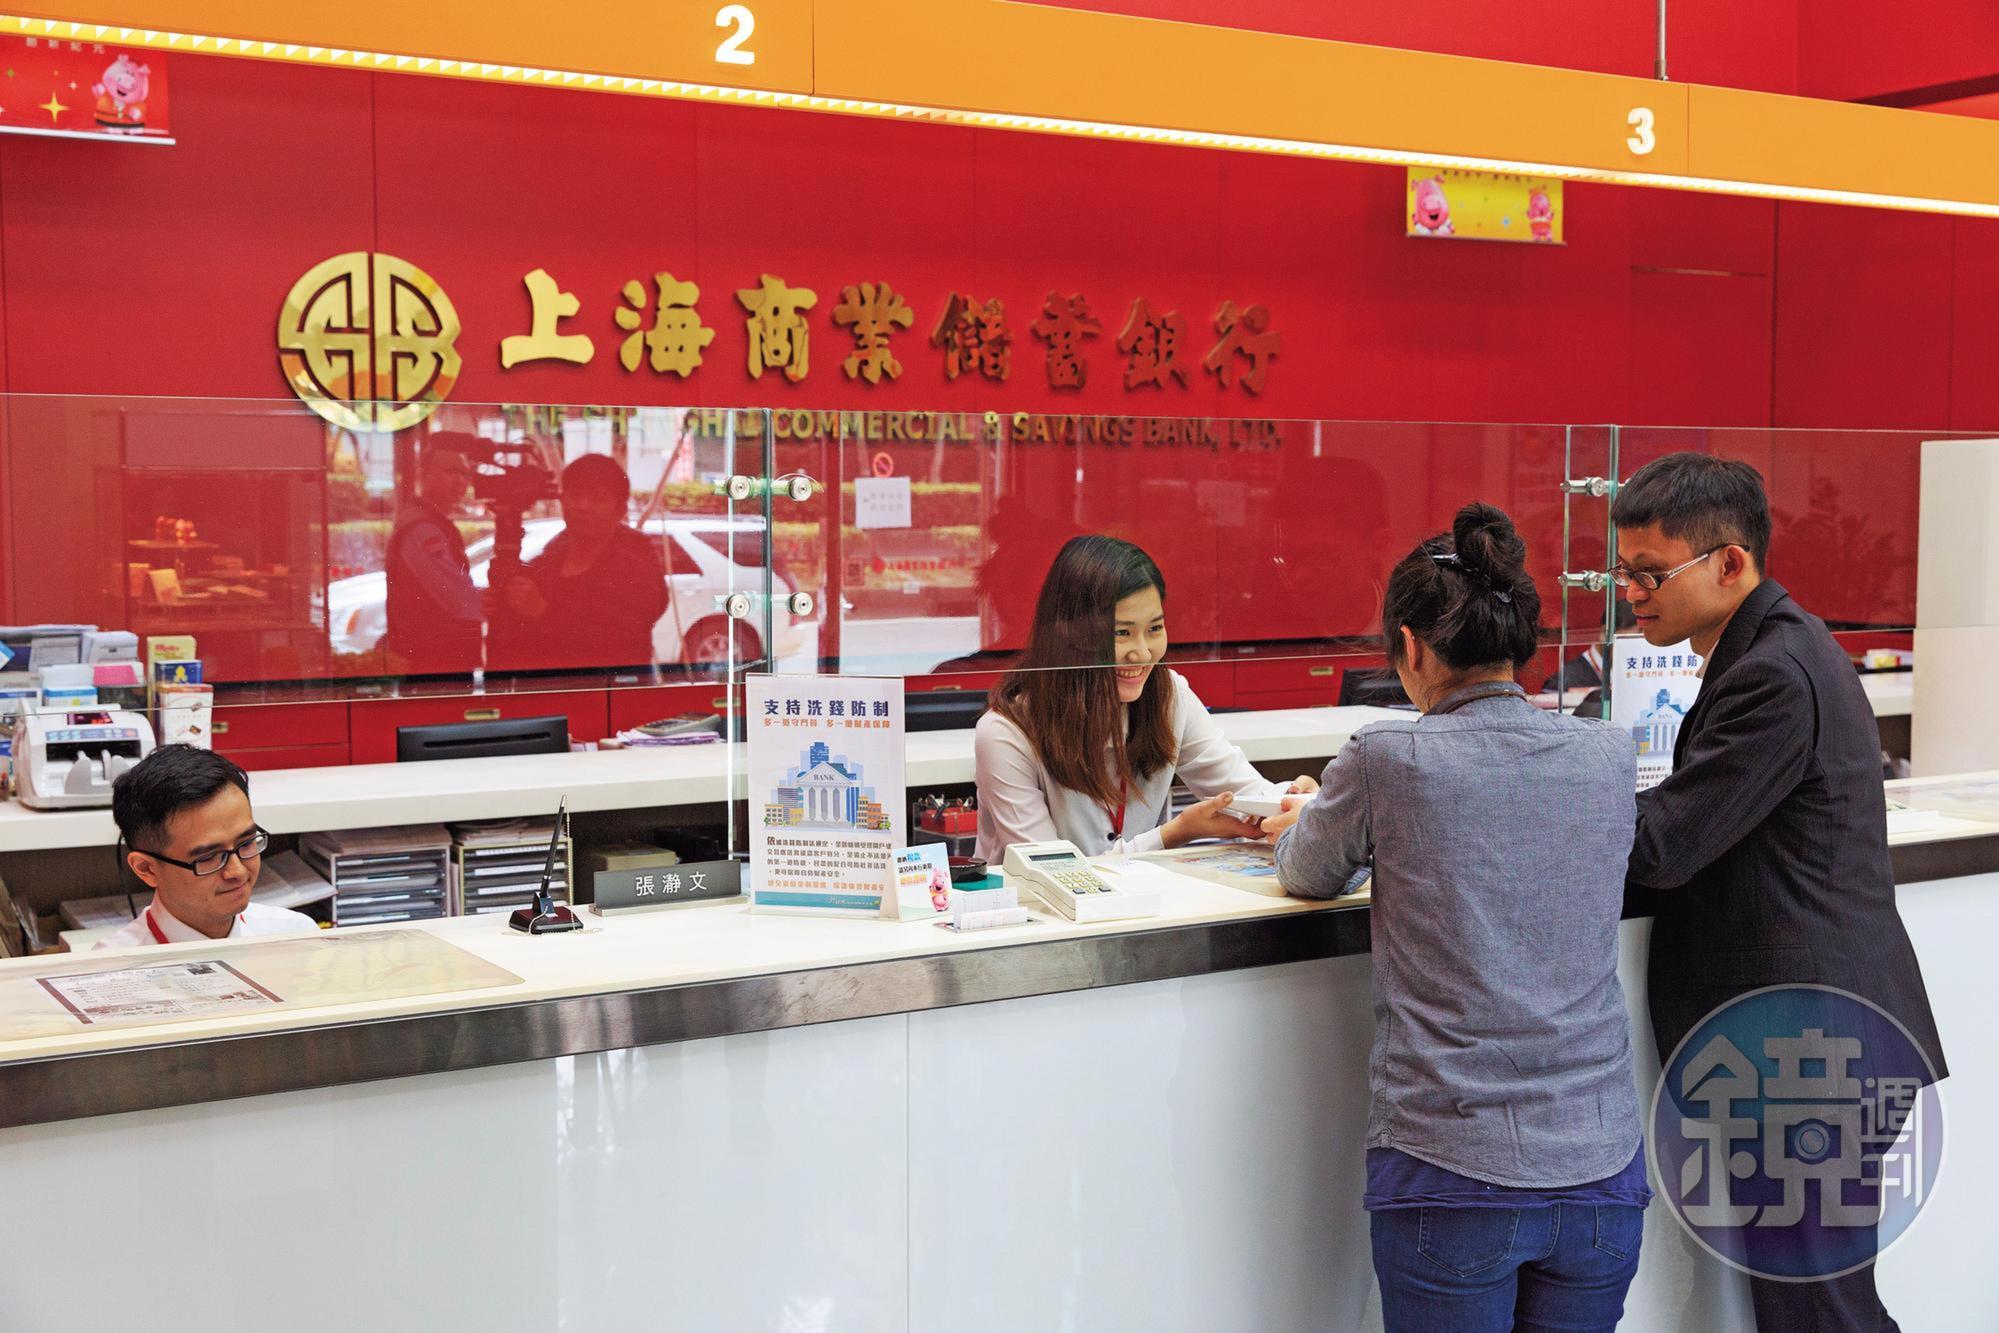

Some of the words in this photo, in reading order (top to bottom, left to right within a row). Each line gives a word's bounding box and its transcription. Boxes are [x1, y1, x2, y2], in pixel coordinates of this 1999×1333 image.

[715, 4, 755, 65] 2
[1626, 107, 1656, 155] 3
[501, 268, 1282, 396] 上海商業儲蓄銀行
[774, 408, 974, 440] COMMERCIAL
[1012, 411, 1134, 443] SAVINGS
[763, 699, 889, 717] 支持洗錢防制
[635, 872, 708, 897] 張瀞文
